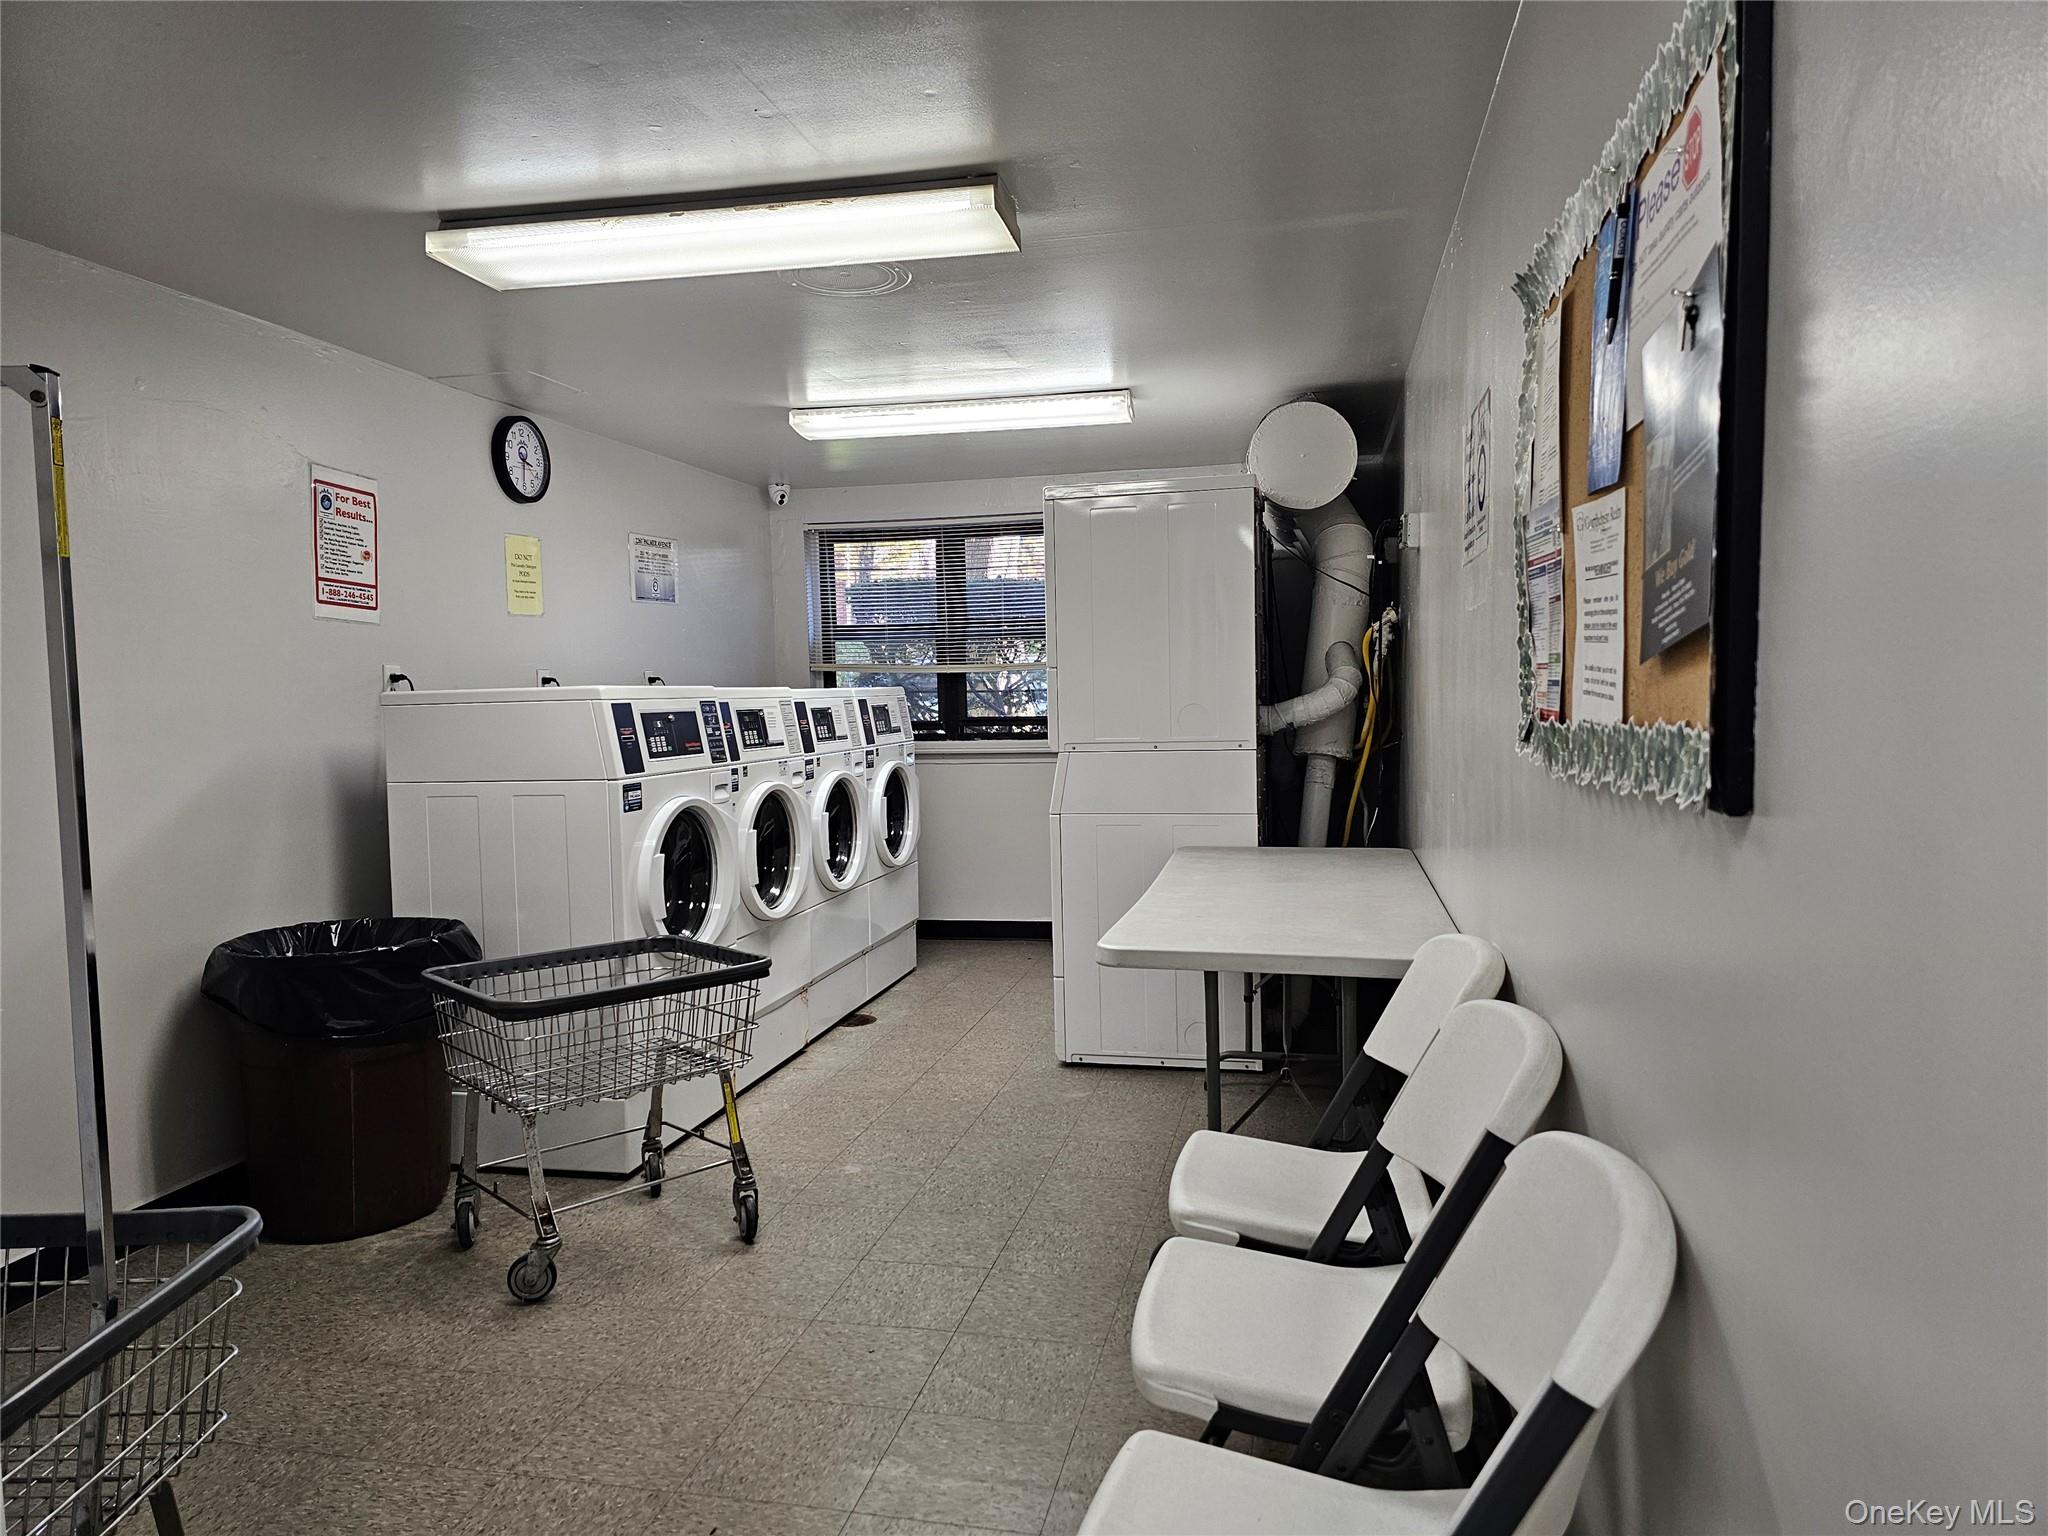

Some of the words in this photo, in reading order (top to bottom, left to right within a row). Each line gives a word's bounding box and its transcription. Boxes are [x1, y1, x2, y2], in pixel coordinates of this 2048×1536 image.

[1638, 158, 1681, 228] Please
[1684, 124, 1702, 172] STOP
[335, 492, 350, 504] For
[352, 496, 371, 509] Best
[335, 507, 373, 524] Results...
[322, 587, 374, 602] 1-888-246-4545
